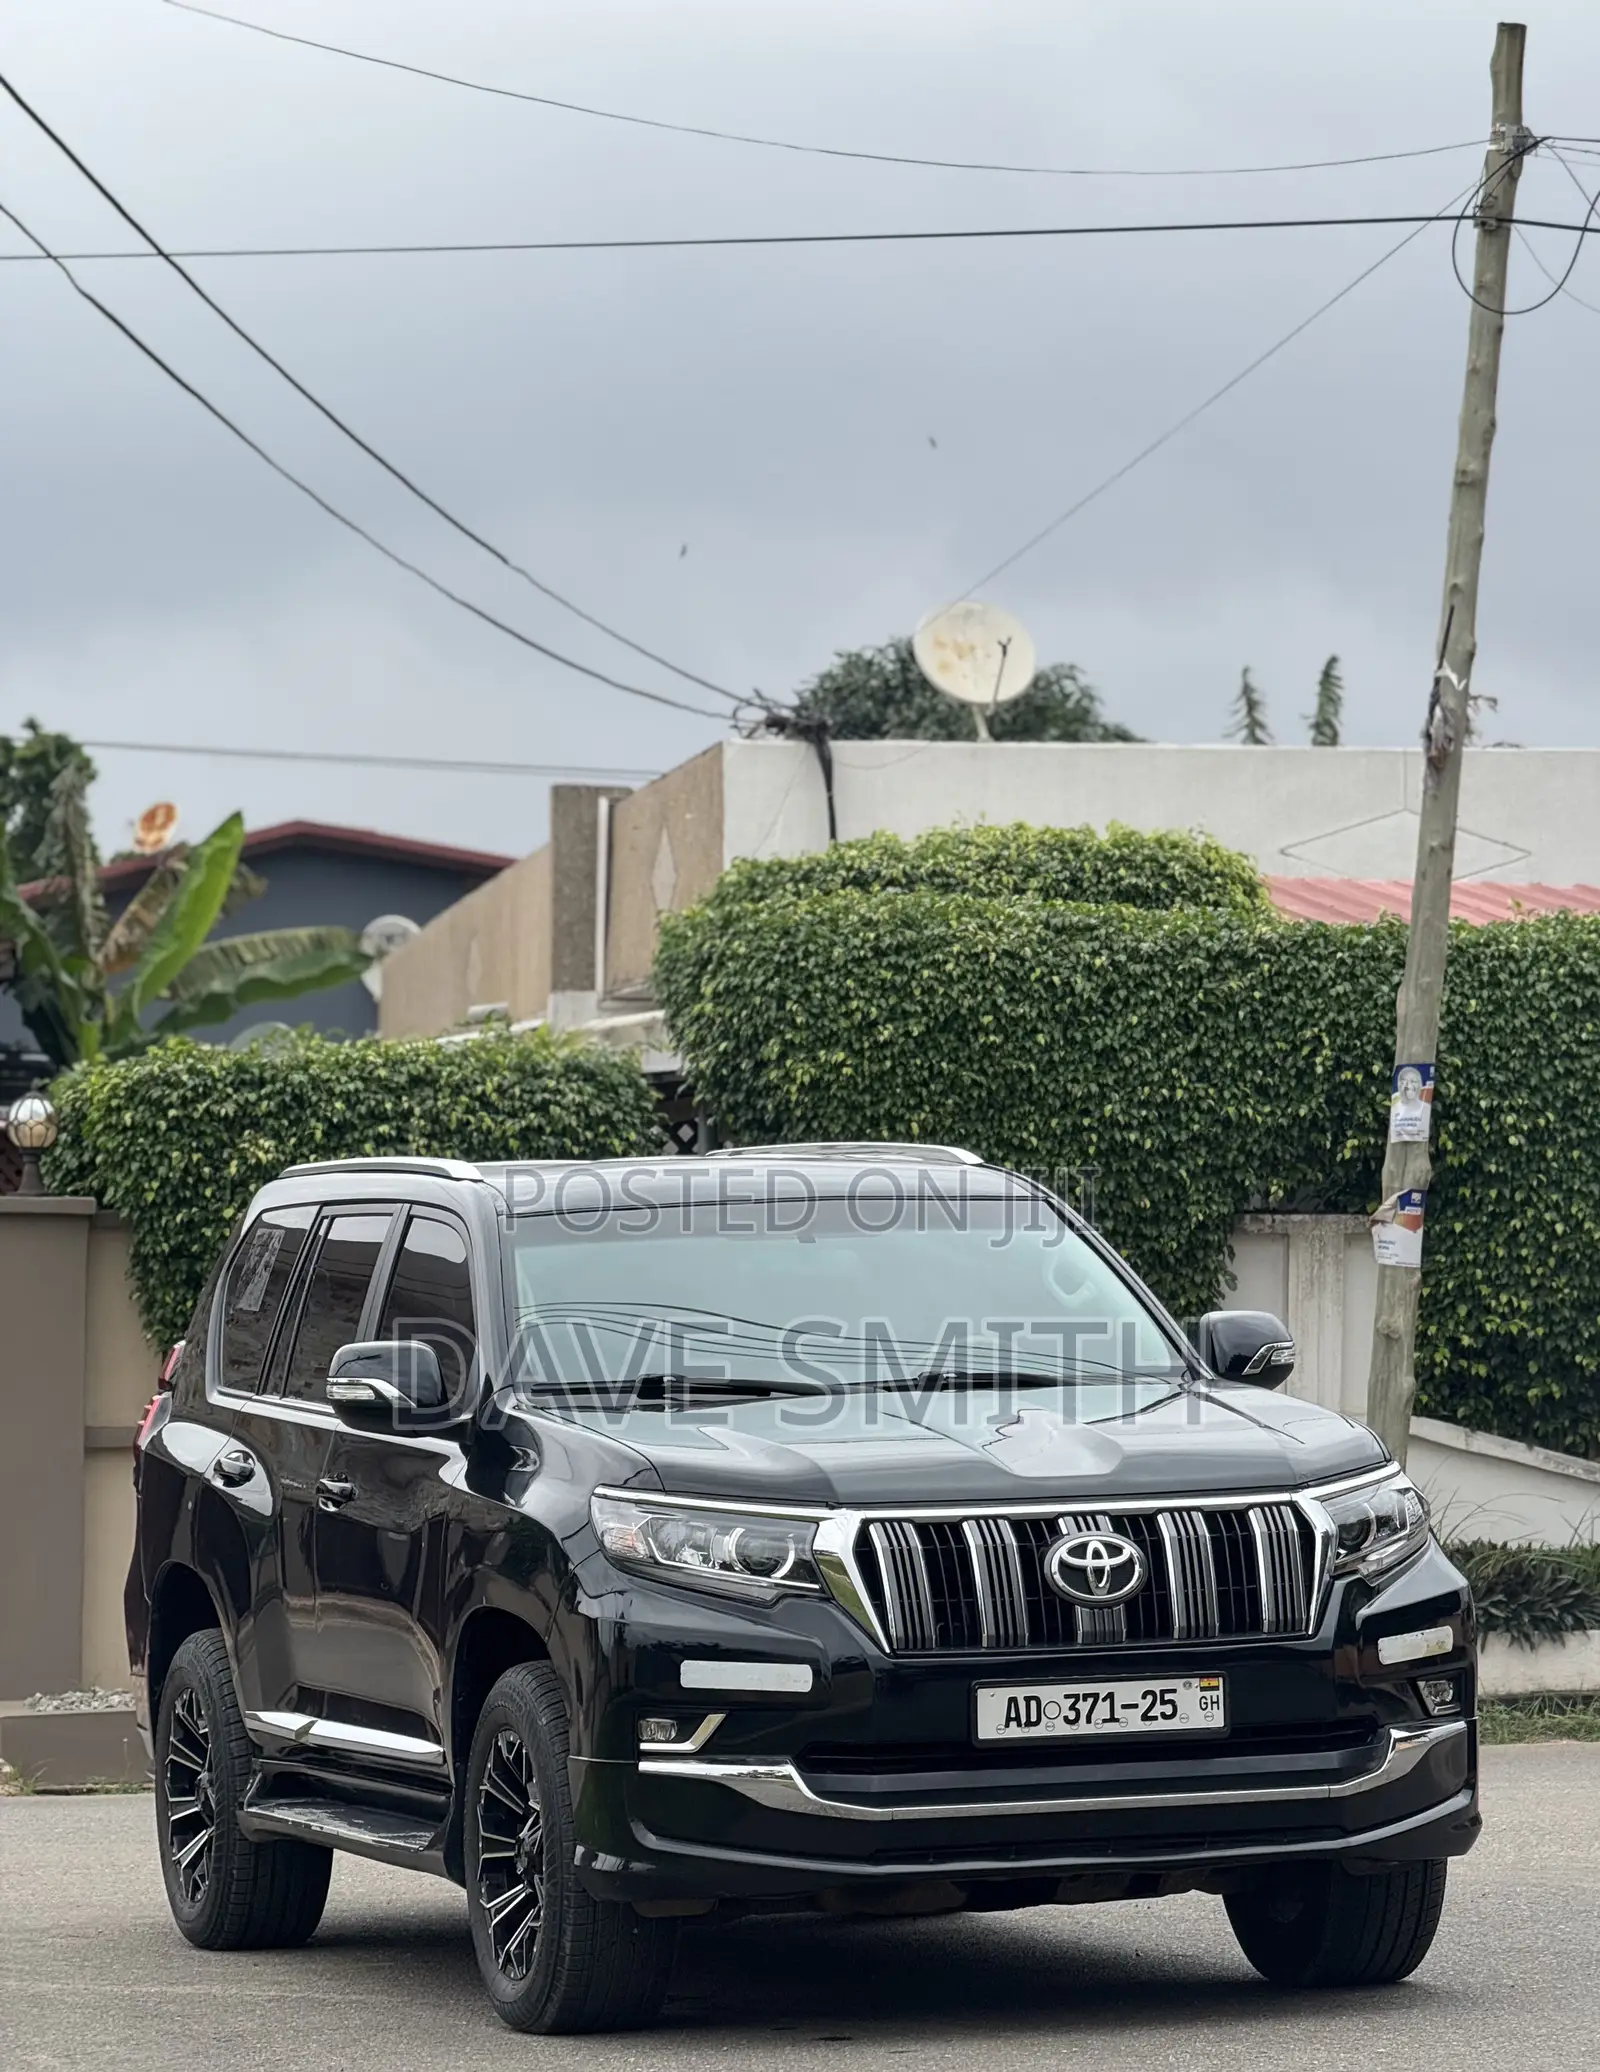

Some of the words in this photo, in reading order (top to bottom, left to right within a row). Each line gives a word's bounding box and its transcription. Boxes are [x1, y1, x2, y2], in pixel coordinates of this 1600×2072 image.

[1004, 1695, 1042, 1729] AD
[1063, 1688, 1178, 1726] 371-25
[1199, 1694, 1220, 1712] GH
